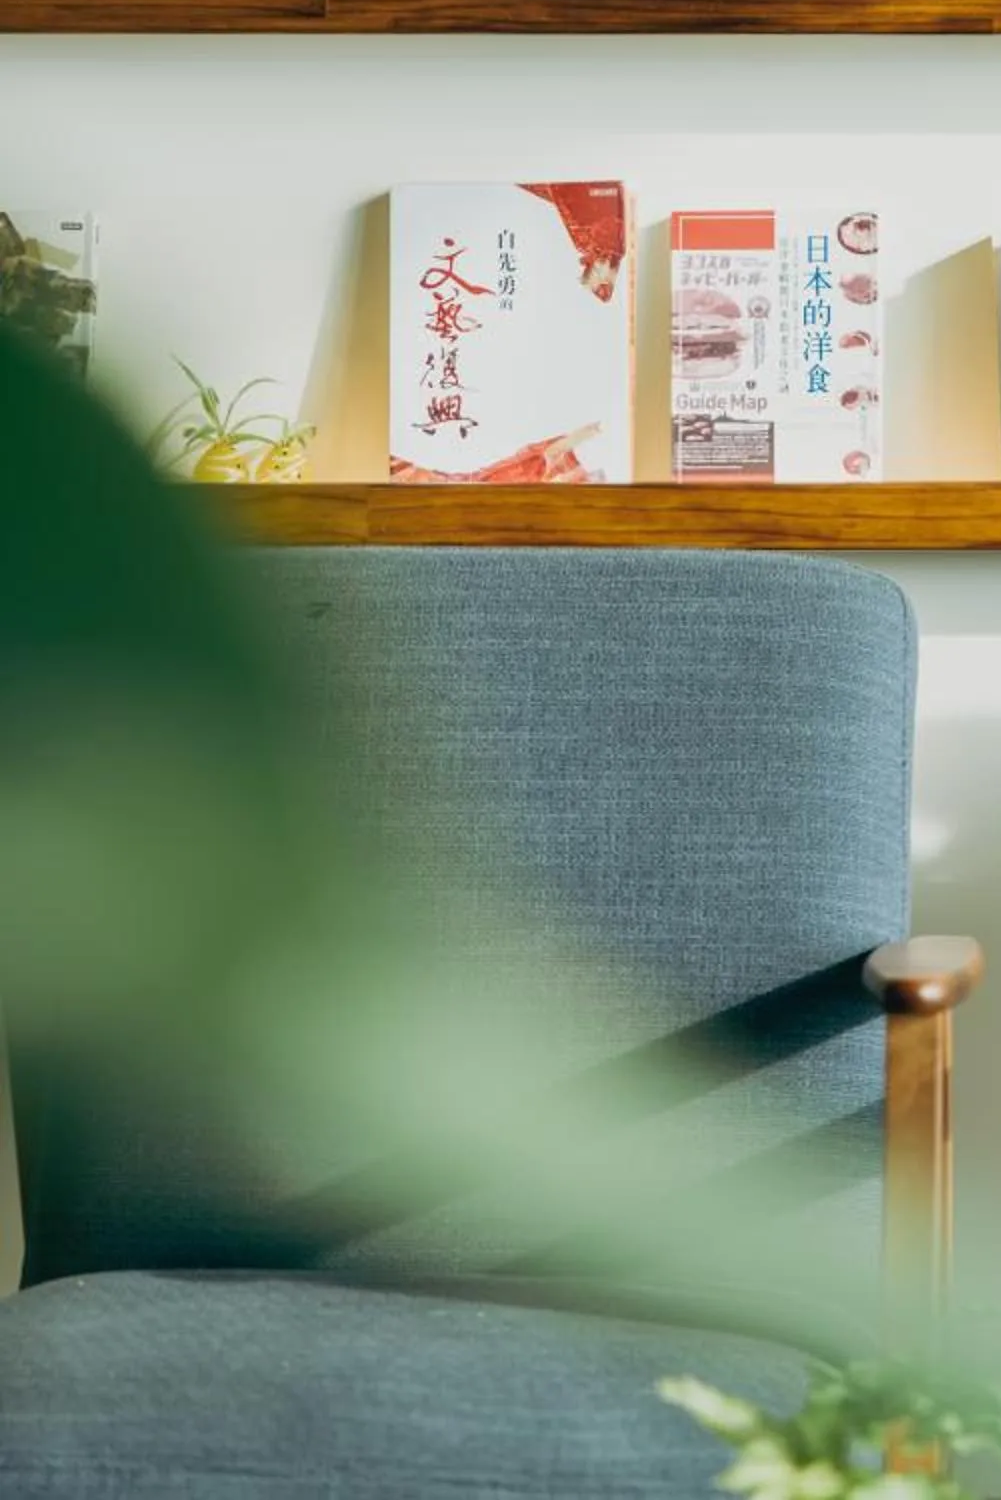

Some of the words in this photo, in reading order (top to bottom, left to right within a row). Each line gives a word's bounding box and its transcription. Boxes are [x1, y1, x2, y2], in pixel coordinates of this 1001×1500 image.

[802, 234, 833, 394] 日本的洋食
[676, 393, 728, 410] Guide
[730, 393, 768, 413] Map
